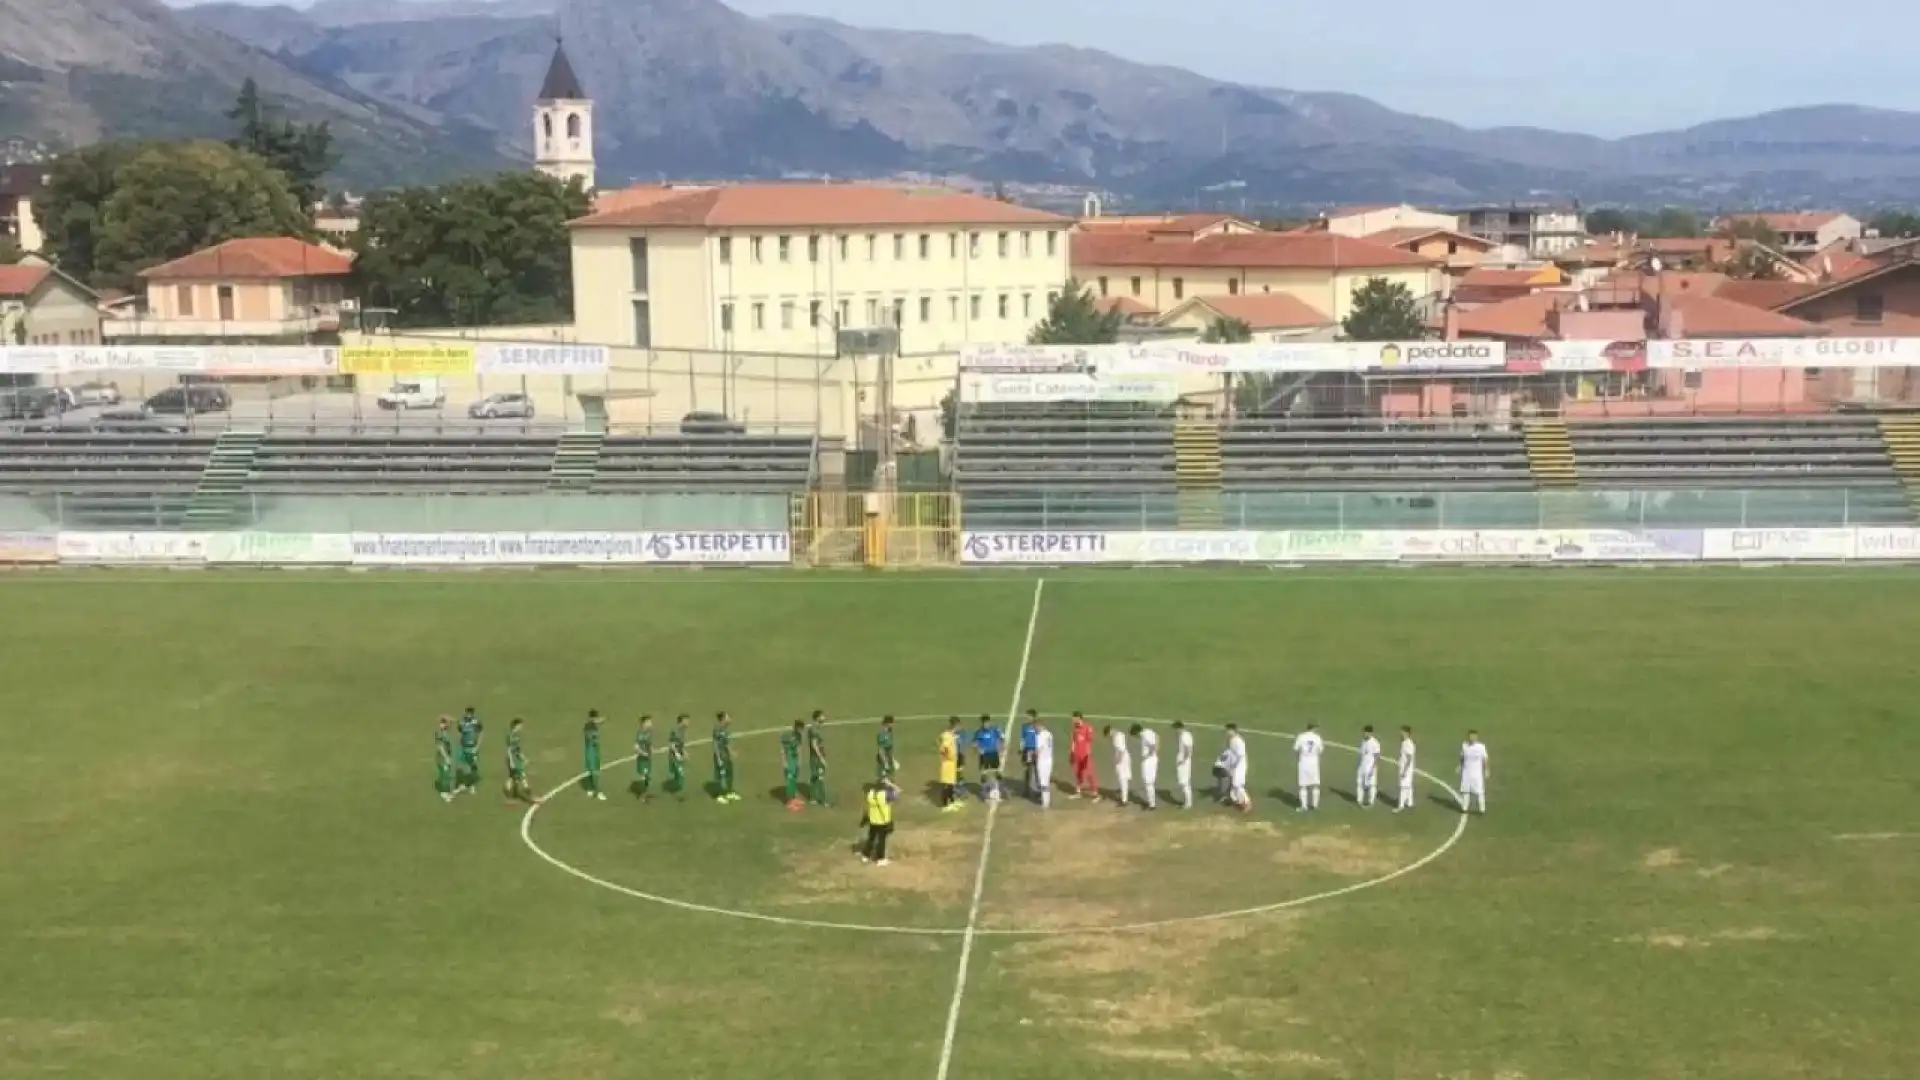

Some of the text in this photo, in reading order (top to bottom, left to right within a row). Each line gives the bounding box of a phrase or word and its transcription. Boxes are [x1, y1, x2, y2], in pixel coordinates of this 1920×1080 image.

[498, 347, 604, 365] SERAFINI
[1407, 343, 1491, 362] pedata
[674, 534, 788, 551] STERPETTI
[992, 534, 1105, 552] STERPETTI
